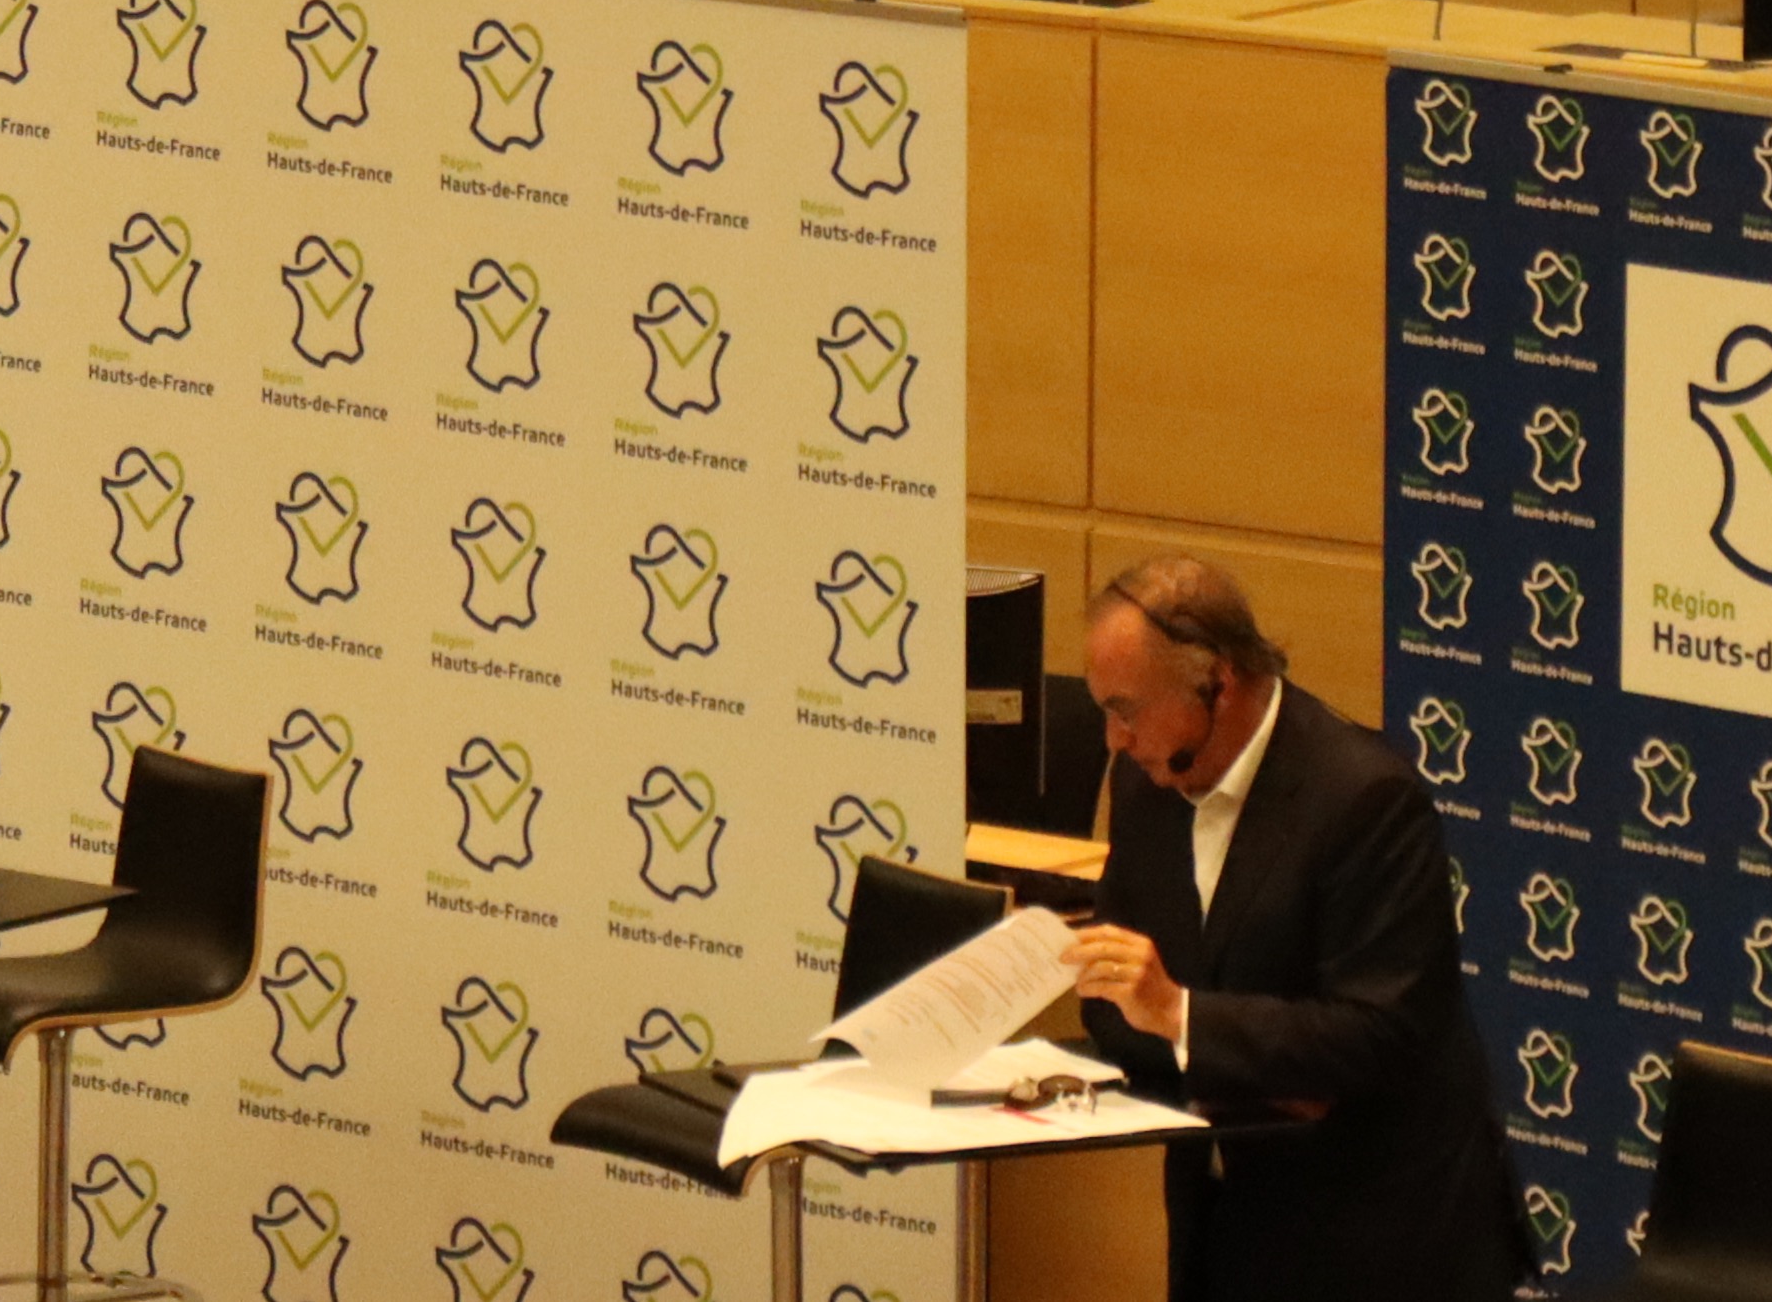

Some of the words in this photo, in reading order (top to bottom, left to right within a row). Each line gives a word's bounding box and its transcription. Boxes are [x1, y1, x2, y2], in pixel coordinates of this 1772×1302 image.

[95, 129, 221, 162] Hauts-de-France
[266, 151, 393, 184] Hauts-de-France
[439, 173, 569, 207] Hauts-de-France
[617, 197, 750, 230] Hauts-de-France
[799, 219, 937, 253] Hauts-de-France
[87, 363, 215, 397] Hauts-de-France
[261, 387, 389, 422] Hauts-de-France
[435, 412, 566, 447] Hauts-de-France
[613, 437, 748, 473] Hauts-de-France
[797, 463, 937, 499] Hauts-de-France
[79, 597, 207, 633] Hauts-de-France
[1652, 583, 1736, 621] Région
[254, 624, 384, 660] Hauts-de-France
[431, 651, 562, 688] Hauts-de-France
[610, 678, 746, 716] Hauts-de-France
[796, 707, 937, 744] Hauts-de-France
[426, 890, 559, 928] Hauts-de-France
[607, 920, 744, 959] Hauts-de-France
[71, 1073, 190, 1106] auts-de-France
[238, 1098, 371, 1137] Hauts-de-France
[420, 1129, 555, 1169] Hauts-de-France
